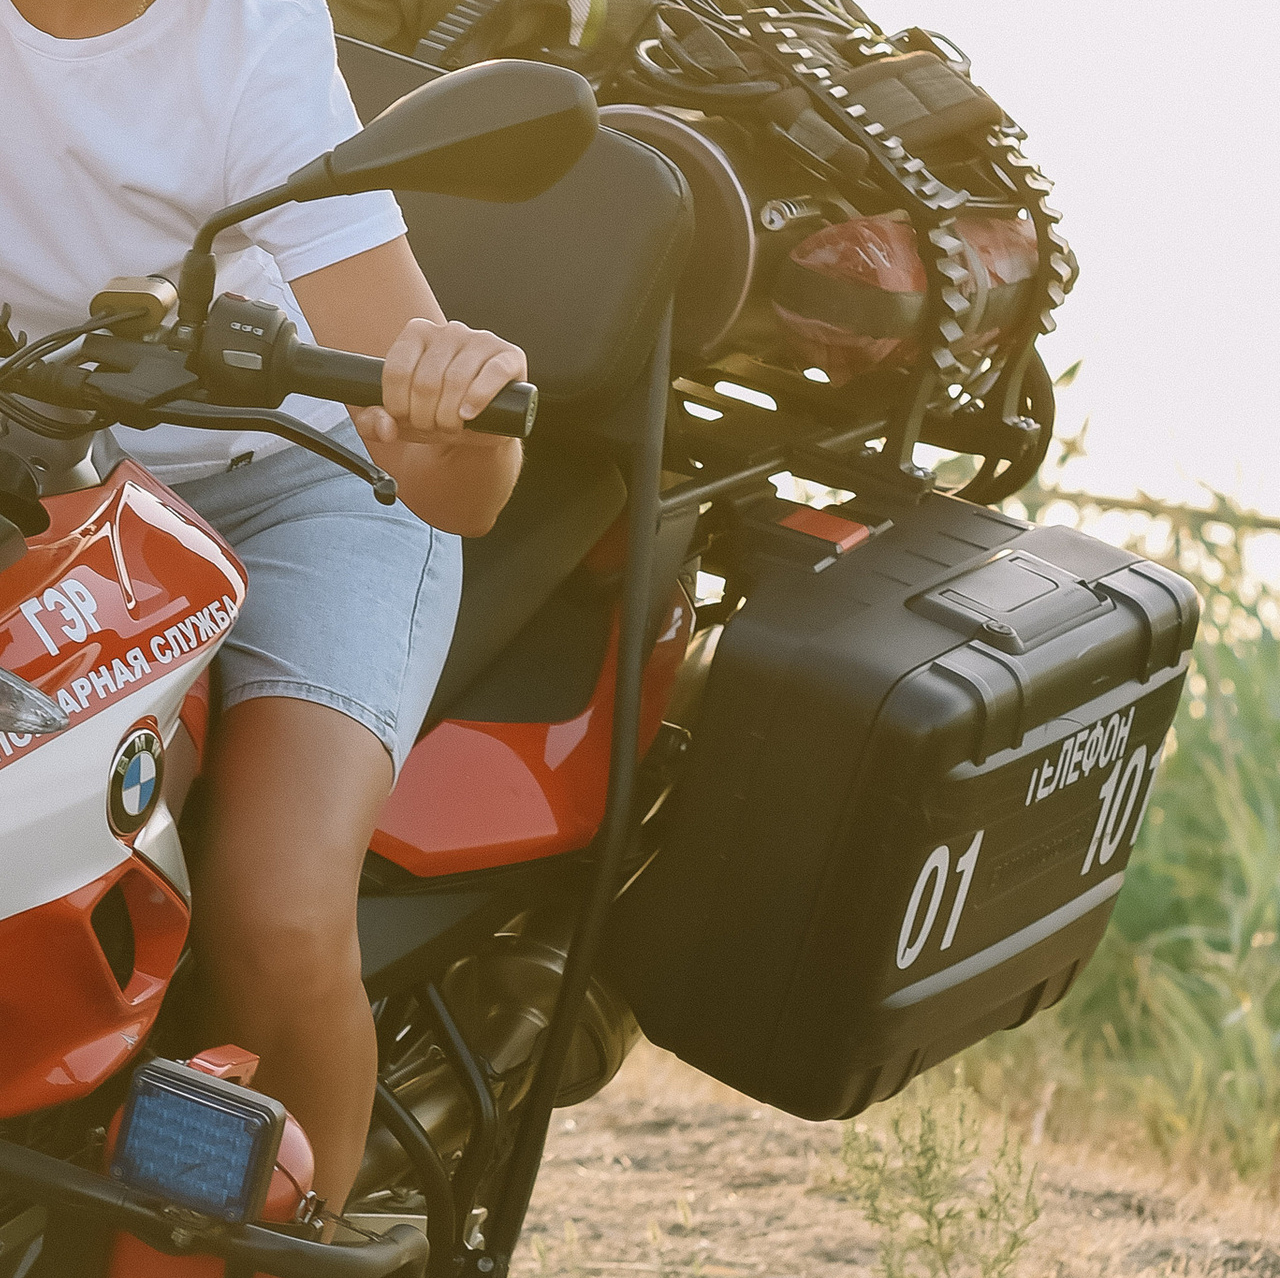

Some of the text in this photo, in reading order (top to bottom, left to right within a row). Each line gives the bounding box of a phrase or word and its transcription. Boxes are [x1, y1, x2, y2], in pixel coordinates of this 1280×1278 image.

[19, 578, 102, 657] ГЭР
[149, 594, 239, 665] СЛУЖБА
[117, 734, 162, 776] BMW
[1080, 739, 1167, 876] 101
[895, 829, 985, 970] 01
